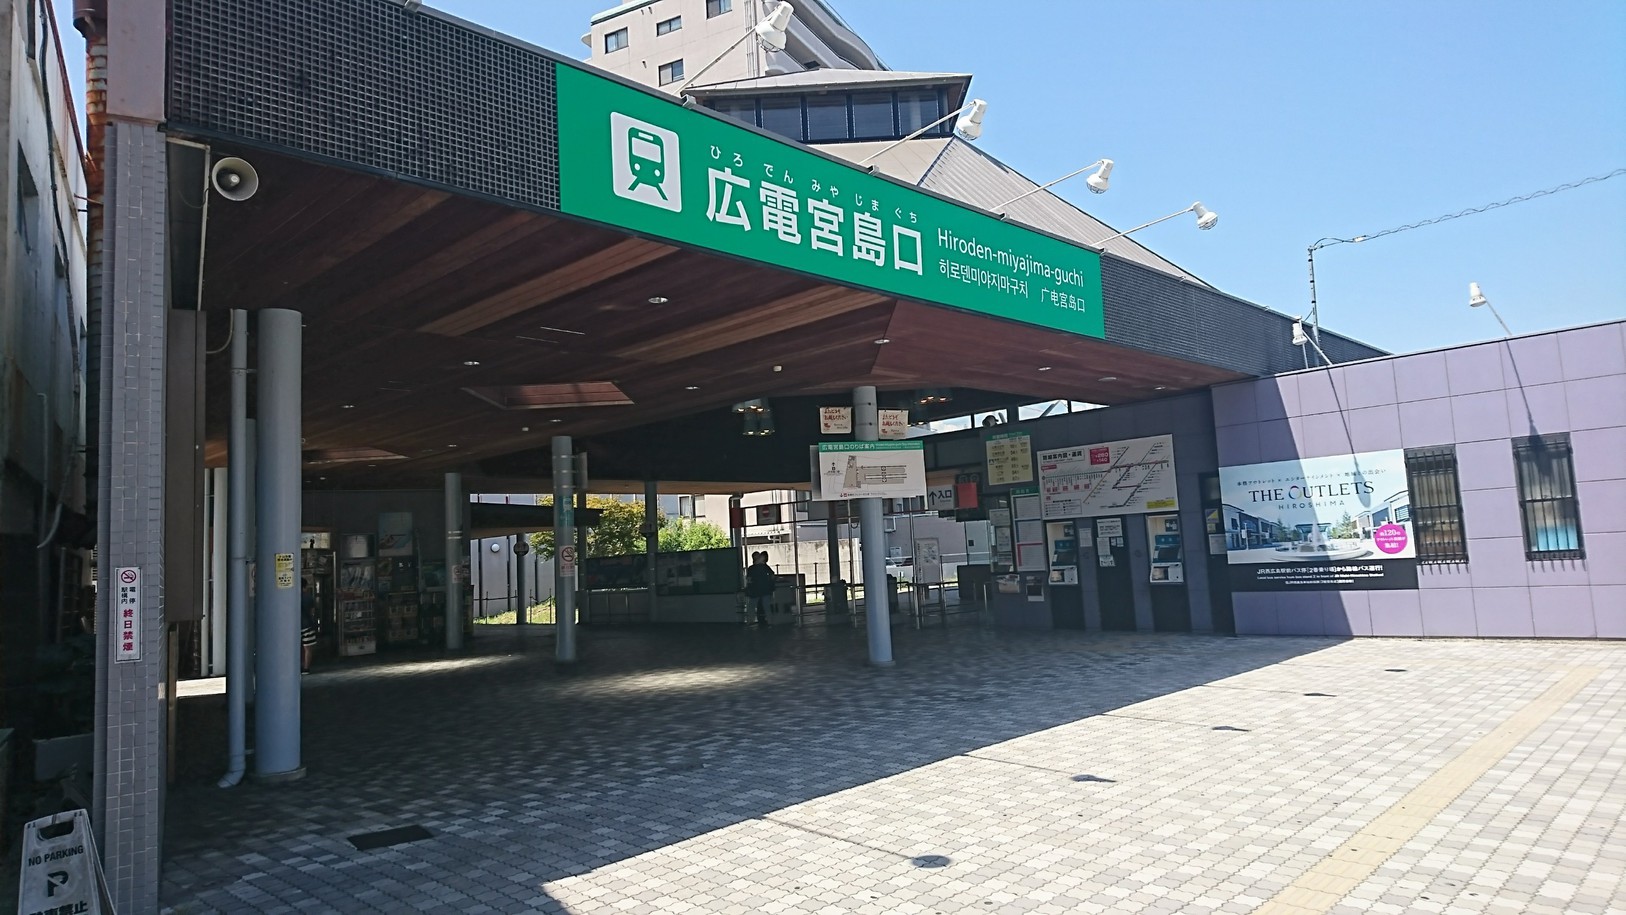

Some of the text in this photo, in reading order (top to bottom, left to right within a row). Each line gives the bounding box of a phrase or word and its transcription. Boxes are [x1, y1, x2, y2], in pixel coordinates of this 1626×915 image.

[706, 166, 923, 276] 広電宮島口
[937, 227, 1084, 288] Hiroden-miyajima-guchi
[938, 258, 1029, 298] 히로덴미야지마구치
[821, 443, 875, 451] 広電宮島口のりば案内
[938, 490, 952, 499] 入口
[1249, 481, 1375, 503] THE OUTLETS
[1278, 500, 1345, 510] HIROSHIMA
[123, 608, 134, 652] 終日禁煙
[28, 845, 84, 866] NO PARKING
